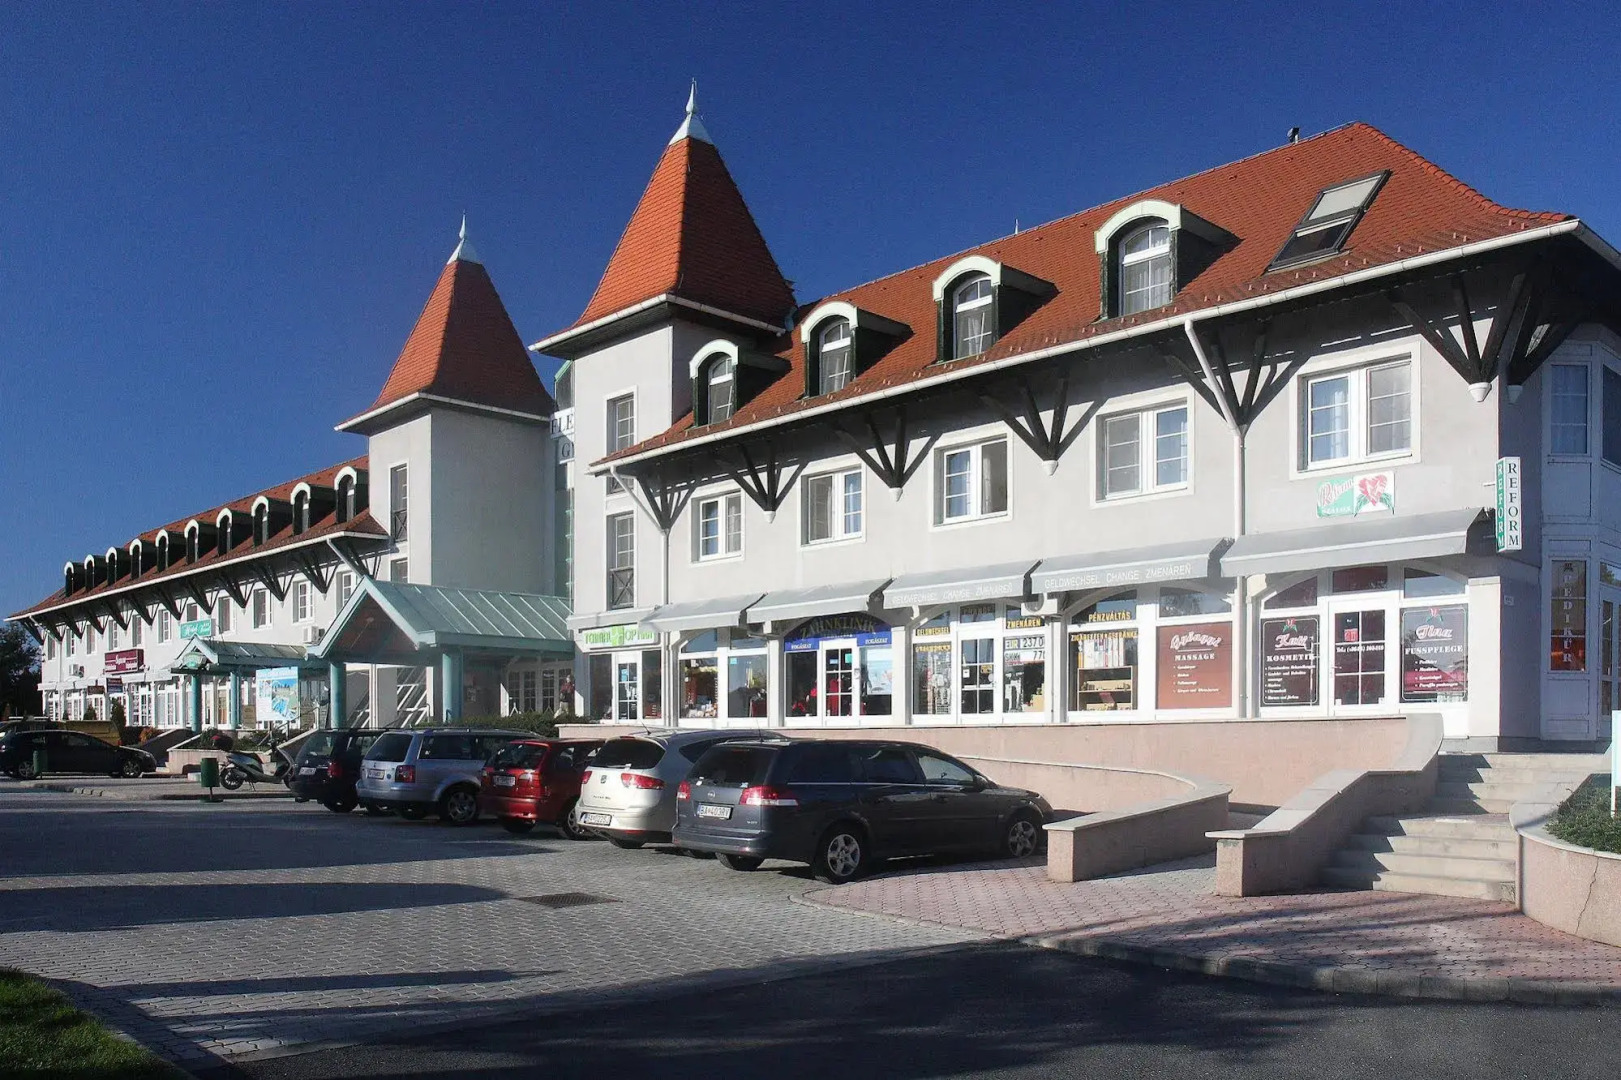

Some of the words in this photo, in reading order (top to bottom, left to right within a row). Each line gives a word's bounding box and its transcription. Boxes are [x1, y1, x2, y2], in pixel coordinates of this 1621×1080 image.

[1497, 464, 1505, 549] REFORM
[1508, 462, 1520, 546] REFORM
[1045, 574, 1100, 590] GELDWECHSEL
[1106, 569, 1140, 582] CHANGE
[1088, 609, 1131, 623] PÉNZVÁLTÁS
[801, 618, 875, 641] ZAHNKLINIK
[1415, 624, 1453, 640] Tina
[865, 637, 888, 645] FOGÁSZAT
[1006, 638, 1019, 649] EUR
[1174, 652, 1215, 662] MASSAGE
[1405, 645, 1463, 655] FUSSPFLEGE
[1266, 653, 1315, 662] KOSMETIK
